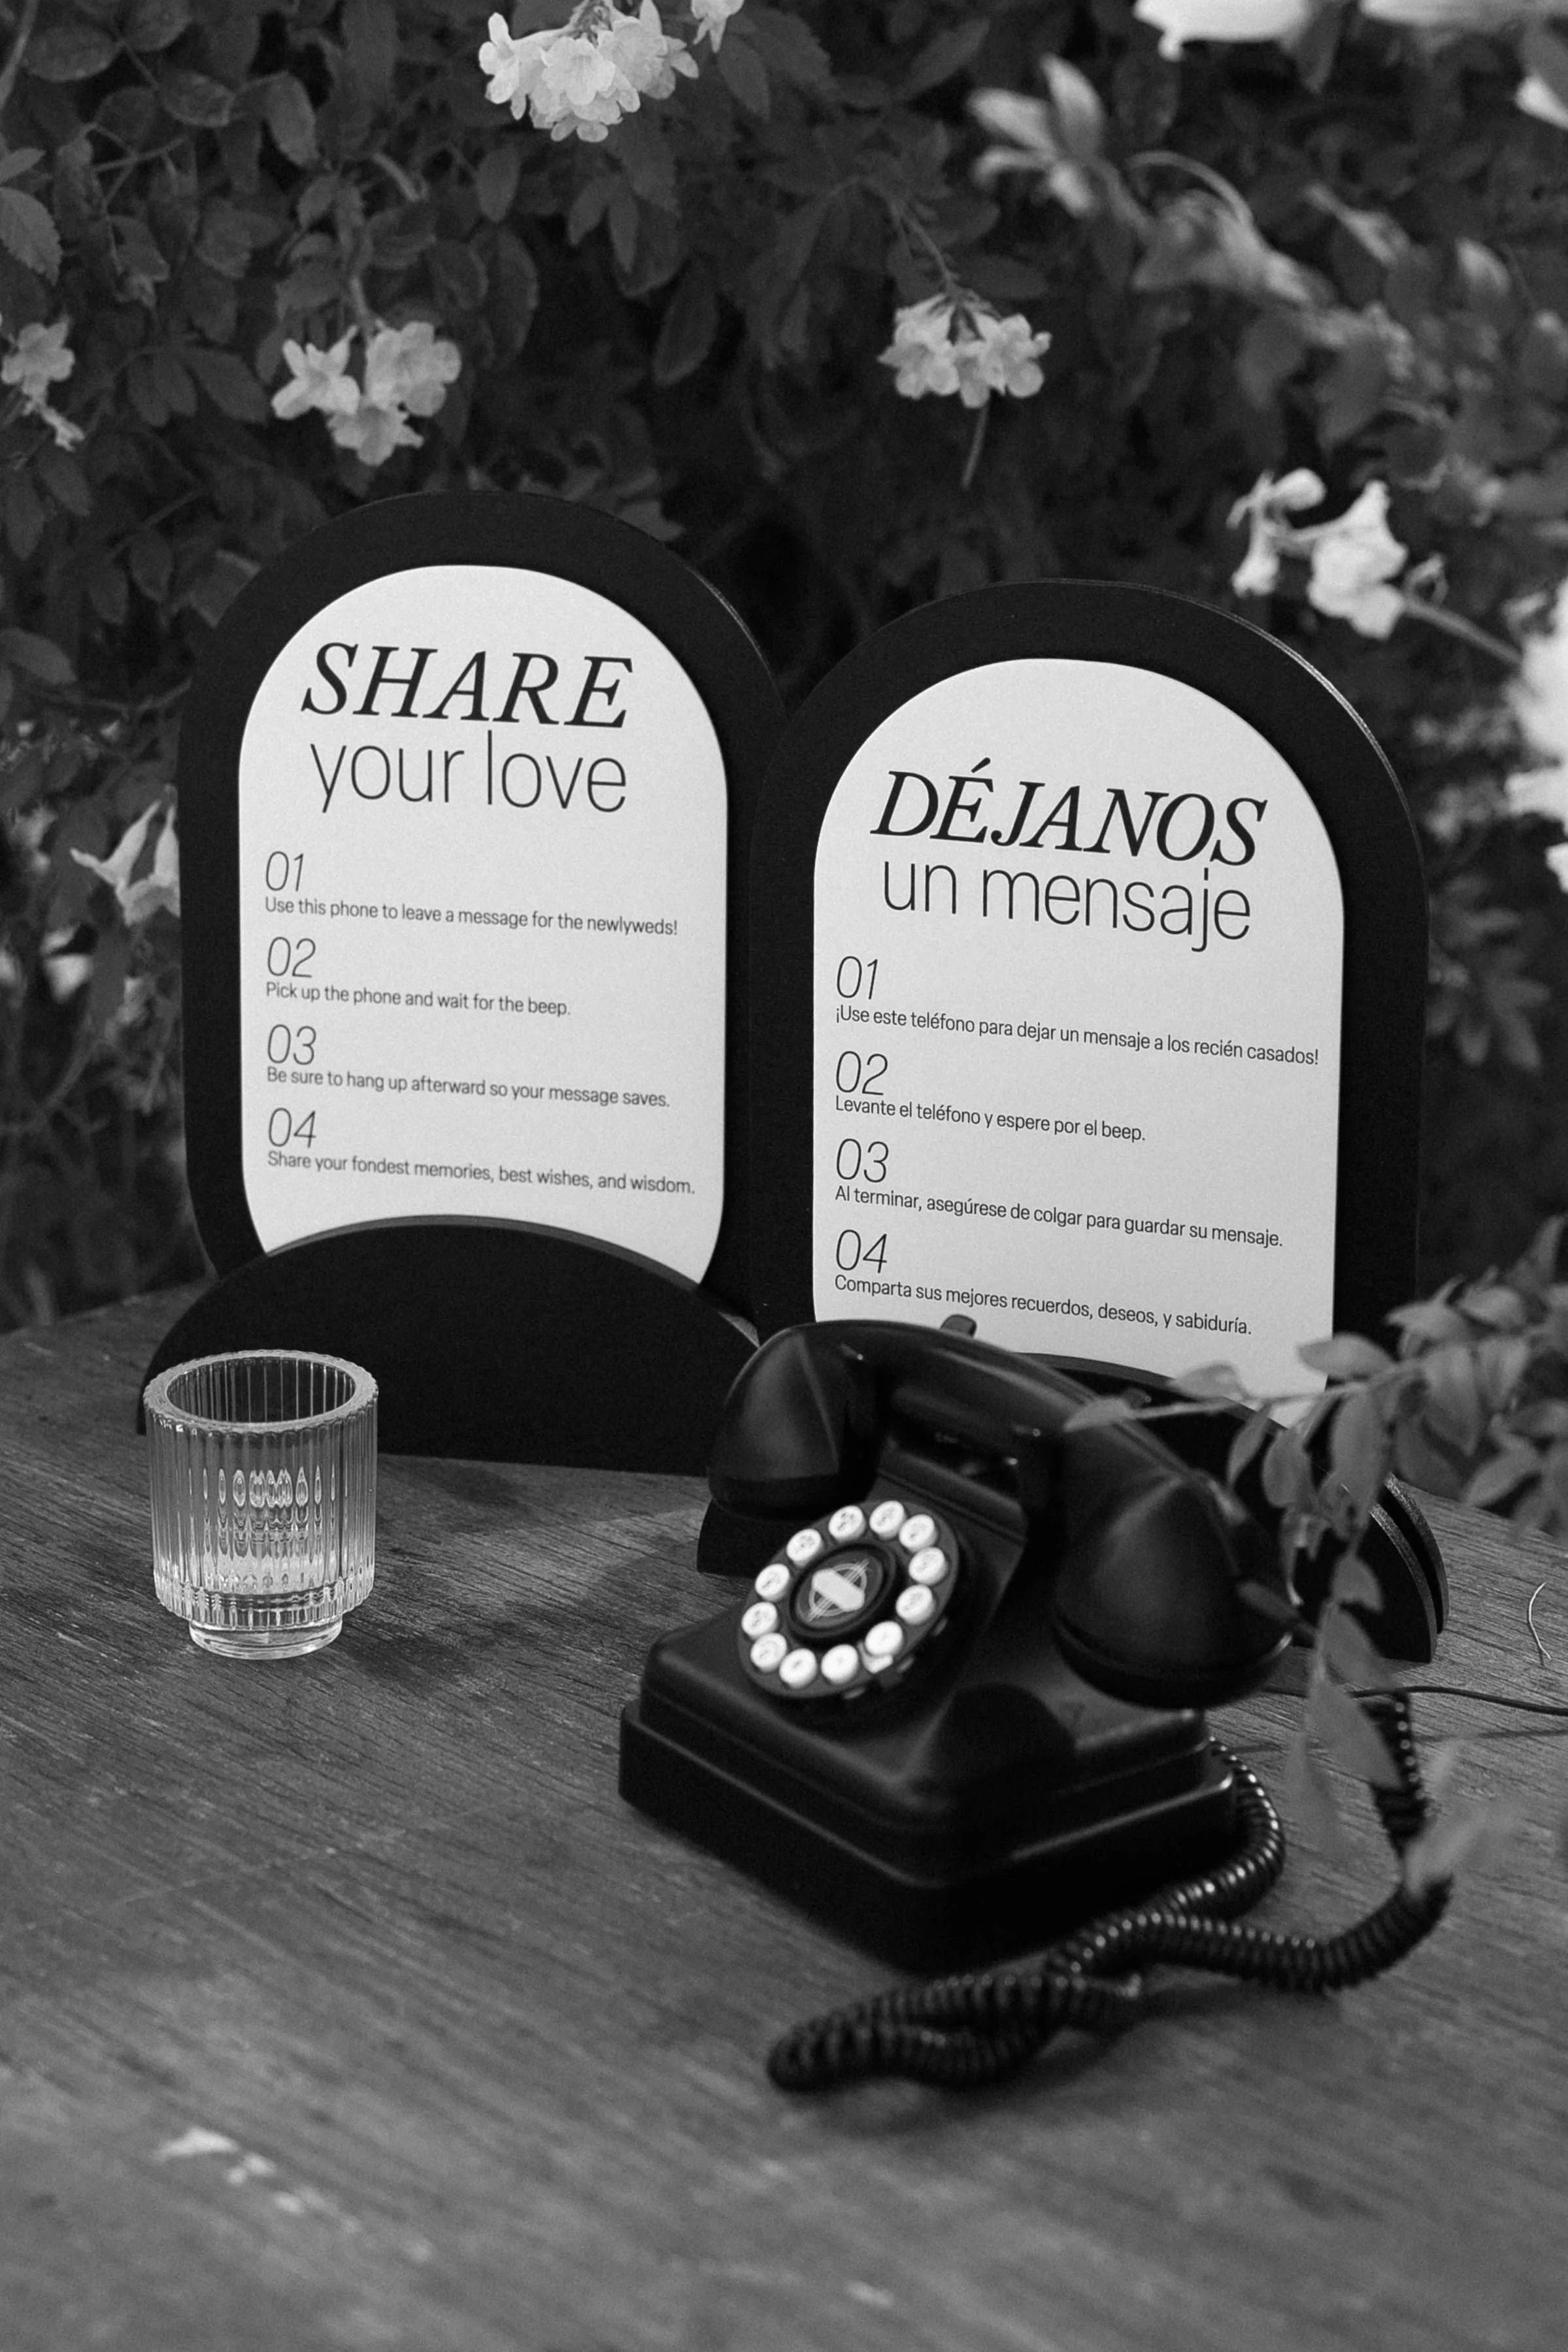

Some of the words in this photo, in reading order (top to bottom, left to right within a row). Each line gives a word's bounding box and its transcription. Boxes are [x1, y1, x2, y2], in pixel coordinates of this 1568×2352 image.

[300, 641, 633, 729] SHARE
[309, 743, 465, 814] your
[487, 729, 627, 813] love
[869, 756, 1269, 867] DÉJANOS
[265, 850, 304, 892] 01
[265, 896, 295, 913] Use
[298, 898, 326, 915] this
[330, 900, 378, 918] phone
[382, 904, 398, 919] to
[402, 903, 442, 922] leave
[445, 910, 454, 922] a
[458, 911, 528, 930] message
[531, 910, 554, 928] for
[557, 913, 584, 930] the
[587, 915, 678, 935] newlyweds!
[884, 860, 957, 915] un
[982, 867, 1251, 953] mensaje
[267, 936, 316, 979] 02
[836, 955, 878, 1000] 01
[266, 981, 297, 998] Pick
[301, 988, 321, 1002] up
[324, 985, 350, 1002] the
[353, 987, 401, 1005] phone
[405, 991, 433, 1007] and
[437, 993, 469, 1009] wait
[473, 993, 495, 1011] for
[498, 995, 524, 1013] the
[527, 997, 571, 1018] beep.
[267, 1024, 317, 1066] 03
[836, 1004, 870, 1024] ¡Use
[873, 1010, 907, 1026] este
[910, 1011, 975, 1033] teléfono
[978, 1021, 1013, 1037] para
[1016, 1020, 1057, 1043] dejar
[1059, 1028, 1080, 1043] un
[1083, 1031, 1151, 1052] mensaje
[1154, 1037, 1163, 1050] a
[1167, 1034, 1190, 1053] los
[1193, 1039, 1243, 1058] recién
[1246, 1045, 1319, 1066] casados!
[267, 1066, 288, 1083] Be
[291, 1071, 324, 1085] sure
[327, 1071, 343, 1086] to
[346, 1071, 384, 1092] hang
[388, 1078, 408, 1093] up
[411, 1075, 486, 1096] afterward
[490, 1084, 509, 1097] so
[510, 1085, 545, 1101] your
[548, 1087, 619, 1107] message
[622, 1092, 670, 1107] saves.
[835, 1050, 889, 1096] 02
[267, 1107, 316, 1149] 04
[835, 1094, 896, 1117] Levante
[899, 1101, 912, 1118] el
[916, 1103, 981, 1125] teléfono
[984, 1113, 993, 1129] y
[996, 1114, 1050, 1132] espere
[1054, 1120, 1081, 1135] por
[1084, 1119, 1097, 1136] el
[1101, 1120, 1146, 1143] beep.
[268, 1150, 312, 1169] Share
[315, 1158, 348, 1172] your
[352, 1155, 410, 1175] fondest
[414, 1164, 494, 1183] memories,
[499, 1166, 533, 1184] best
[536, 1168, 593, 1190] wishes,
[597, 1173, 627, 1190] and
[629, 1175, 695, 1194] wisdom.
[836, 1137, 890, 1184] 03
[835, 1185, 850, 1201] Al
[854, 1188, 922, 1212] terminar,
[926, 1198, 1007, 1218] asegúrese
[1010, 1202, 1031, 1220] de
[1033, 1206, 1083, 1228] colgar
[1086, 1214, 1121, 1230] para
[1124, 1218, 1186, 1236] guardar
[1189, 1225, 1208, 1239] su
[1211, 1227, 1283, 1249] mensaje.
[835, 1229, 888, 1274] 04
[835, 1274, 912, 1298] Comparta
[916, 1286, 942, 1301] sus
[946, 1288, 1008, 1308] mejores
[1011, 1296, 1093, 1320] recuerdos,
[1097, 1302, 1158, 1327] deseos,
[1162, 1313, 1173, 1329] y
[1175, 1312, 1252, 1335] sabiduría.
